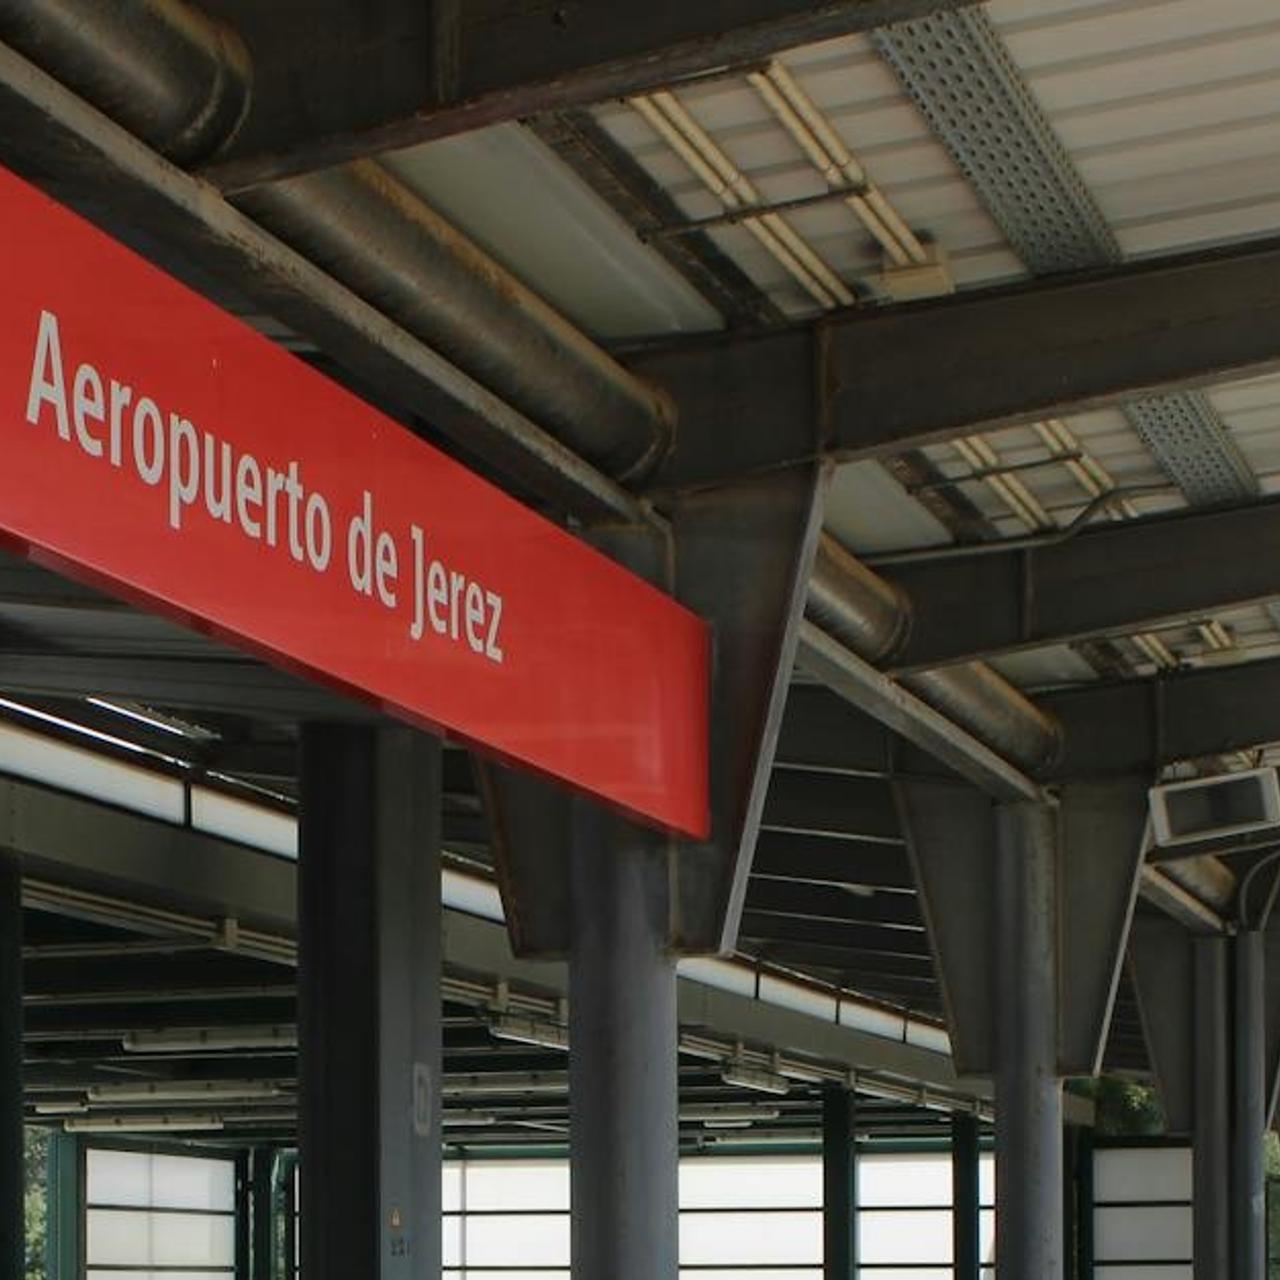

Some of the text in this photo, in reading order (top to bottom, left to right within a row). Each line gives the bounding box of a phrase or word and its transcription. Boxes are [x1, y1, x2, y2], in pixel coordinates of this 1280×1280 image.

[26, 309, 504, 664] Aeropuerto de Jerez
